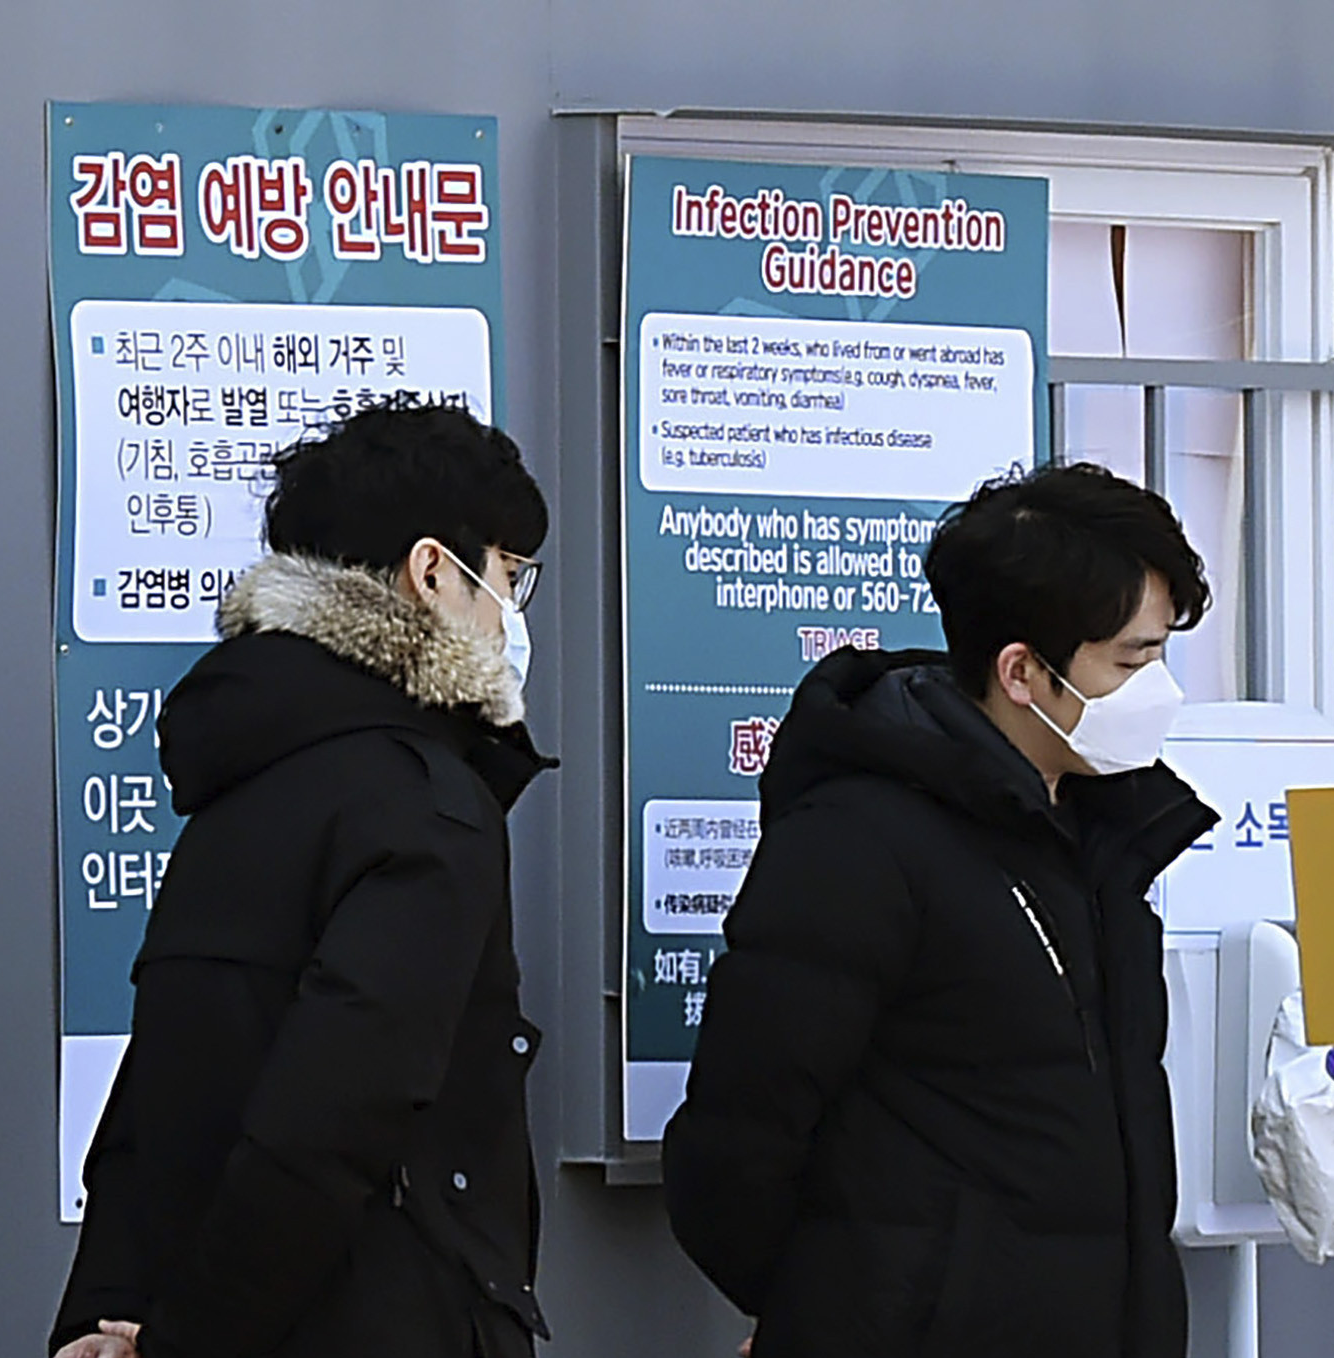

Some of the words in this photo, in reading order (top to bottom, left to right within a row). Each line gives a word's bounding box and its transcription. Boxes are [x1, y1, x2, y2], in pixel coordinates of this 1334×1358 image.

[72, 153, 183, 253] 감염
[201, 157, 310, 258] 예방
[326, 160, 487, 261] 안내문
[673, 186, 821, 240] Infection
[830, 194, 1004, 250] Prevention
[764, 246, 915, 296] Guidance
[116, 331, 163, 373] 최근
[171, 334, 210, 373] 2주
[218, 333, 266, 374] 이내
[272, 335, 320, 375] 해외
[328, 335, 375, 376] 거주
[382, 336, 406, 376] 및
[662, 333, 700, 352] Within
[703, 336, 723, 353] the
[727, 336, 748, 355] last
[751, 336, 759, 355] 2
[806, 340, 829, 358] who
[832, 339, 861, 359] lived
[864, 340, 890, 360] from
[893, 346, 905, 360] or
[909, 345, 937, 362] went
[939, 345, 981, 364] abroad
[983, 347, 1005, 366] has
[662, 358, 692, 378] fever
[695, 363, 708, 378] or
[712, 362, 777, 383] respiratory
[964, 371, 998, 392] fever,
[662, 388, 687, 403] sore
[118, 386, 214, 427] 여행자로
[222, 386, 268, 427] 발열
[276, 386, 323, 427] 또는
[661, 420, 724, 441] Suspected
[727, 424, 770, 443] patient
[774, 427, 798, 443] who
[801, 427, 822, 444] has
[825, 427, 884, 446] infectious
[886, 429, 932, 449] disease
[117, 438, 179, 482] (기침,
[128, 494, 212, 538] 인후통)
[659, 504, 751, 542] Anybody
[756, 507, 798, 540] who
[803, 509, 841, 541] has
[845, 511, 942, 546] symptom
[685, 540, 787, 574] described
[793, 542, 812, 575] is
[816, 544, 893, 577] allowed
[898, 546, 922, 579] to
[117, 569, 191, 609] 감염병
[716, 575, 829, 613] interphone
[833, 584, 856, 611] or
[729, 717, 784, 776] 感
[84, 774, 157, 834] 이곳
